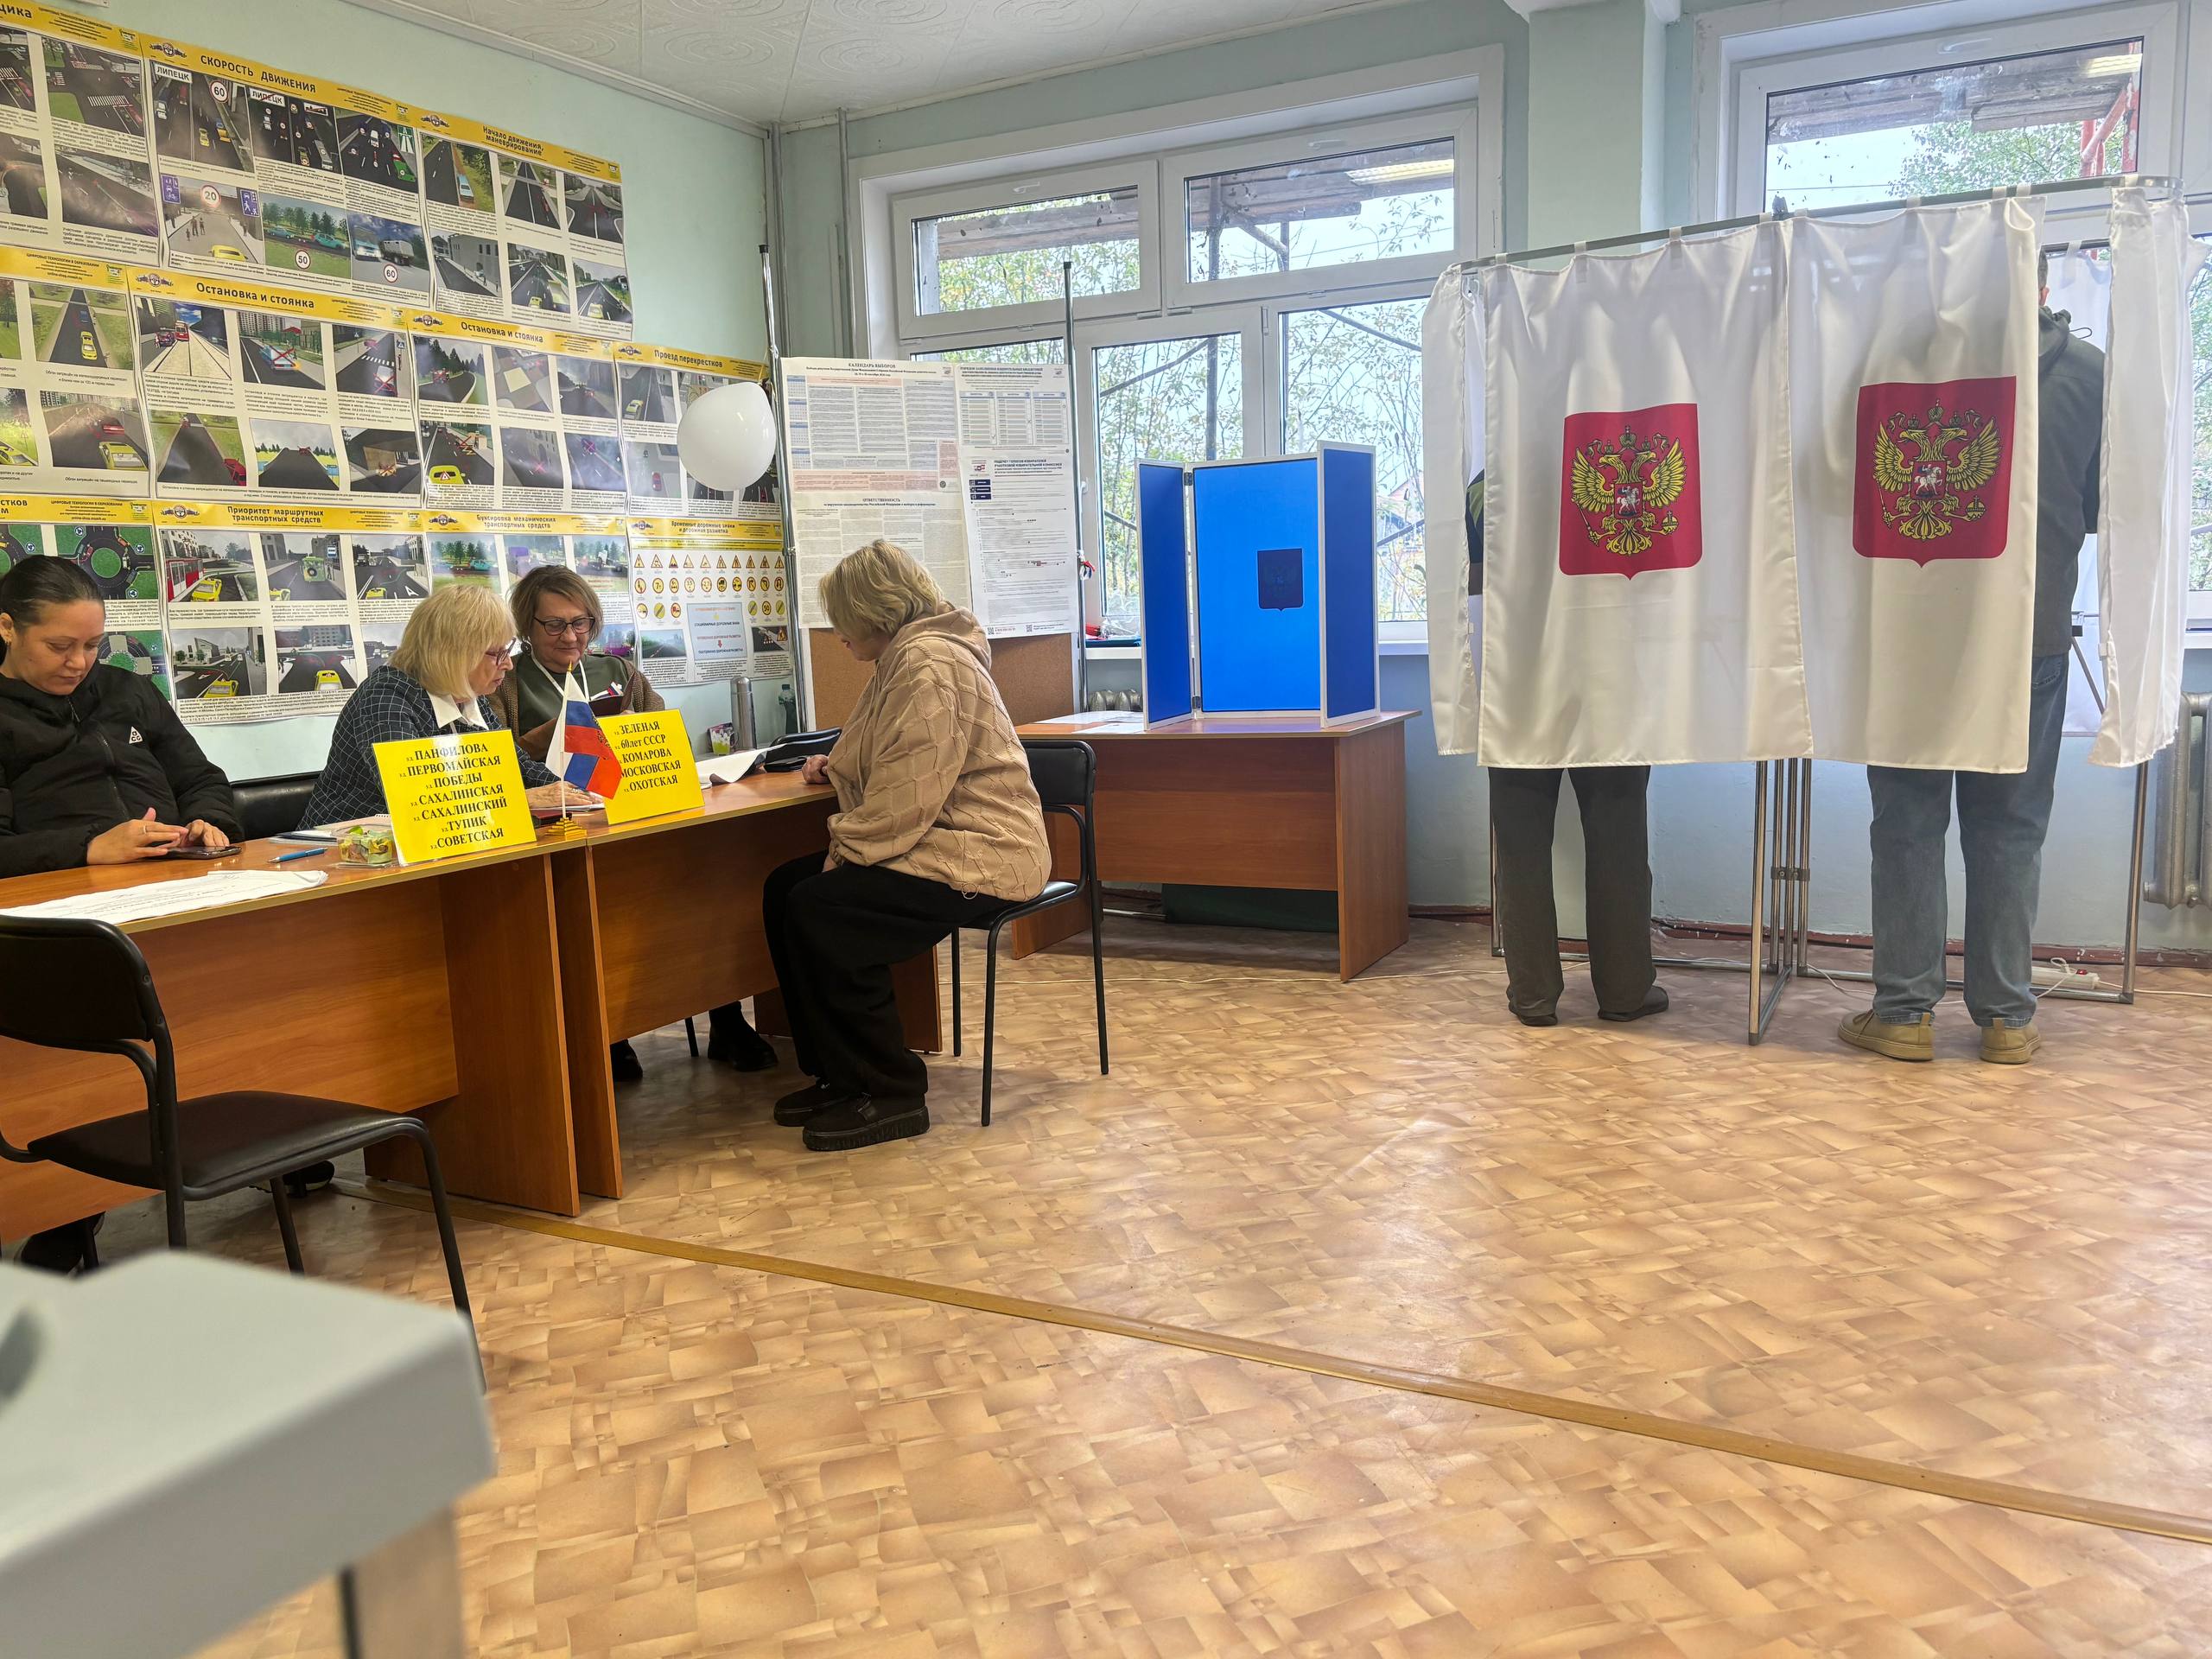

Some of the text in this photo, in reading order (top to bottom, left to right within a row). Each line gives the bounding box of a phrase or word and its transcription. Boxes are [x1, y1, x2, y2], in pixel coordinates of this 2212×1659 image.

[157, 67, 190, 80] ЛИПЕЦК
[200, 55, 316, 93] СКОРОСТЬ ДВИЖЕНИЯ
[213, 86, 226, 97] 60
[483, 125, 544, 151] Начало движения,
[486, 135, 543, 156] маневрирование
[205, 190, 217, 201] 20
[298, 256, 308, 264] 50
[386, 270, 396, 278] 60
[196, 283, 257, 300] Остановка
[270, 296, 315, 308] стоянка
[461, 321, 505, 336] Остановка
[514, 332, 543, 343] стоянка
[654, 349, 723, 367] Проезд перекрестков
[227, 505, 324, 517] Приоритет маршрутных
[232, 514, 289, 523] транспортных
[619, 721, 660, 734] ЗЕЛЕНАЯ
[620, 739, 642, 749] 60лет
[643, 734, 666, 746] СССР
[415, 743, 489, 760] ПАНФИЛОВА
[622, 747, 672, 764] КОМАРОВА
[407, 755, 501, 777] ПЕРВОМАЙСКАЯ
[434, 772, 483, 788] ПОБЕДЫ
[629, 774, 678, 791] ОХОТСКАЯ
[418, 784, 504, 805] САХАЛИНСКАЯ
[422, 797, 508, 820] САХАЛИНСКИЙ
[447, 816, 487, 831] ТУПИК
[436, 828, 505, 849] СОВЕТСКАЯ
